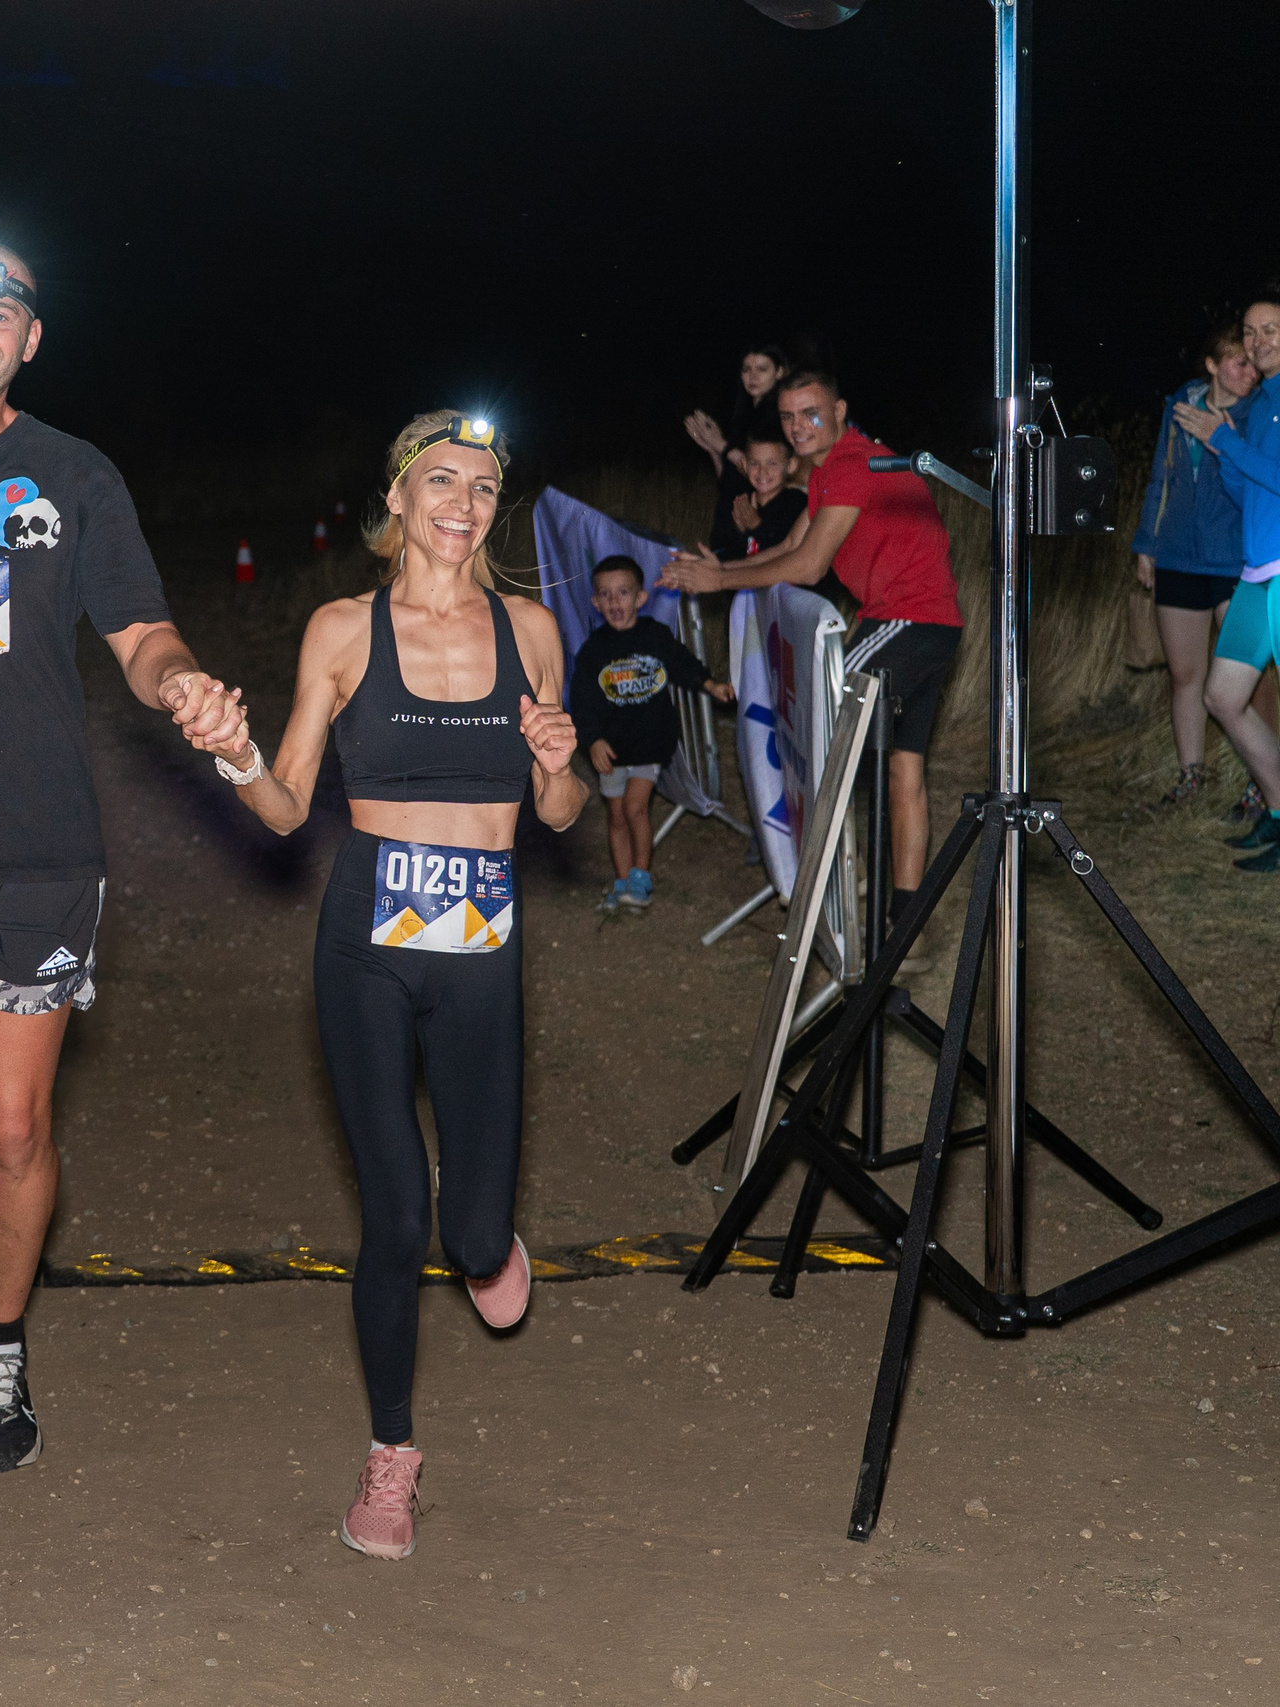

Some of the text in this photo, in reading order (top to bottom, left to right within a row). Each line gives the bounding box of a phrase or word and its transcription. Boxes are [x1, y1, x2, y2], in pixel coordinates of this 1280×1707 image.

[399, 442, 421, 470] Wolf
[617, 675, 658, 694] PARK
[391, 713, 509, 726] JUICY COUTURE
[385, 851, 468, 897] 0129
[476, 883, 487, 894] 6K
[36, 962, 78, 977] NIKE TRAIL
